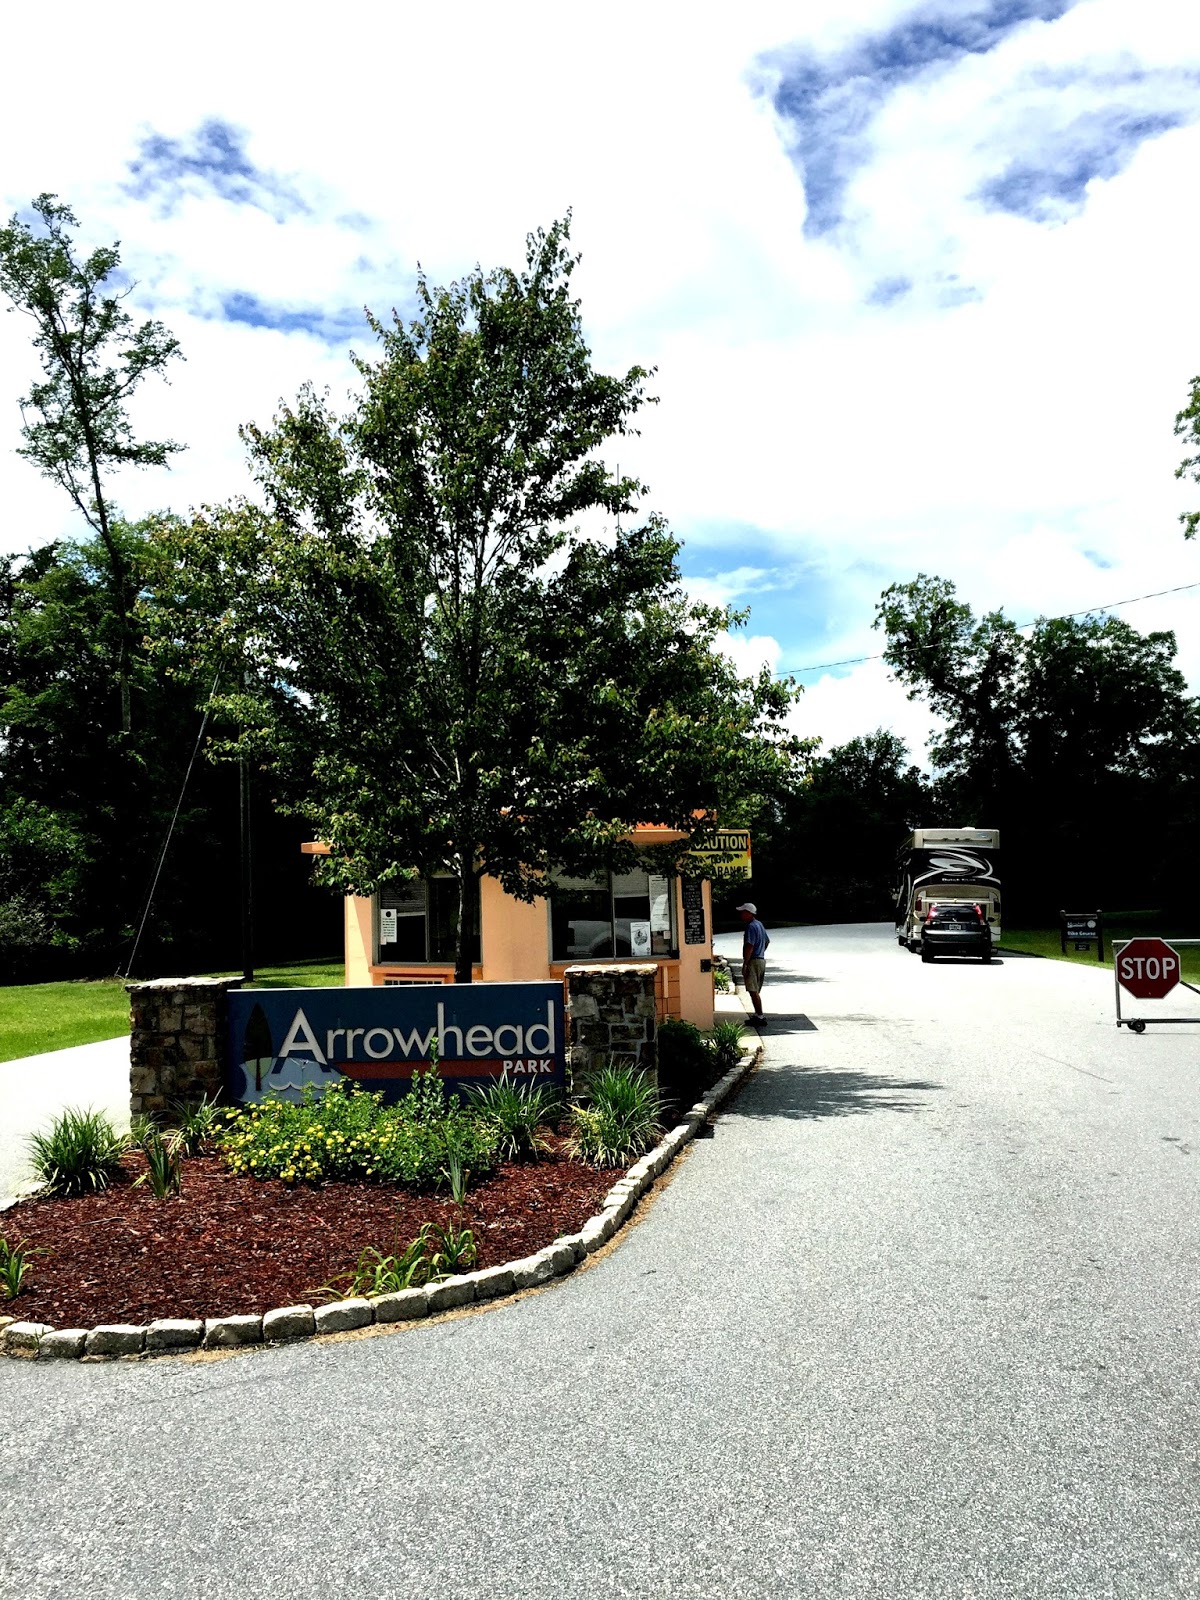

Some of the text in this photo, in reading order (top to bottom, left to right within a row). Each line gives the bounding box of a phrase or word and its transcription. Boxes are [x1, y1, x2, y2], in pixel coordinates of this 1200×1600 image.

[1121, 957, 1176, 980] STOP
[275, 999, 556, 1069] Arrowhead
[503, 1059, 552, 1074] PARK
